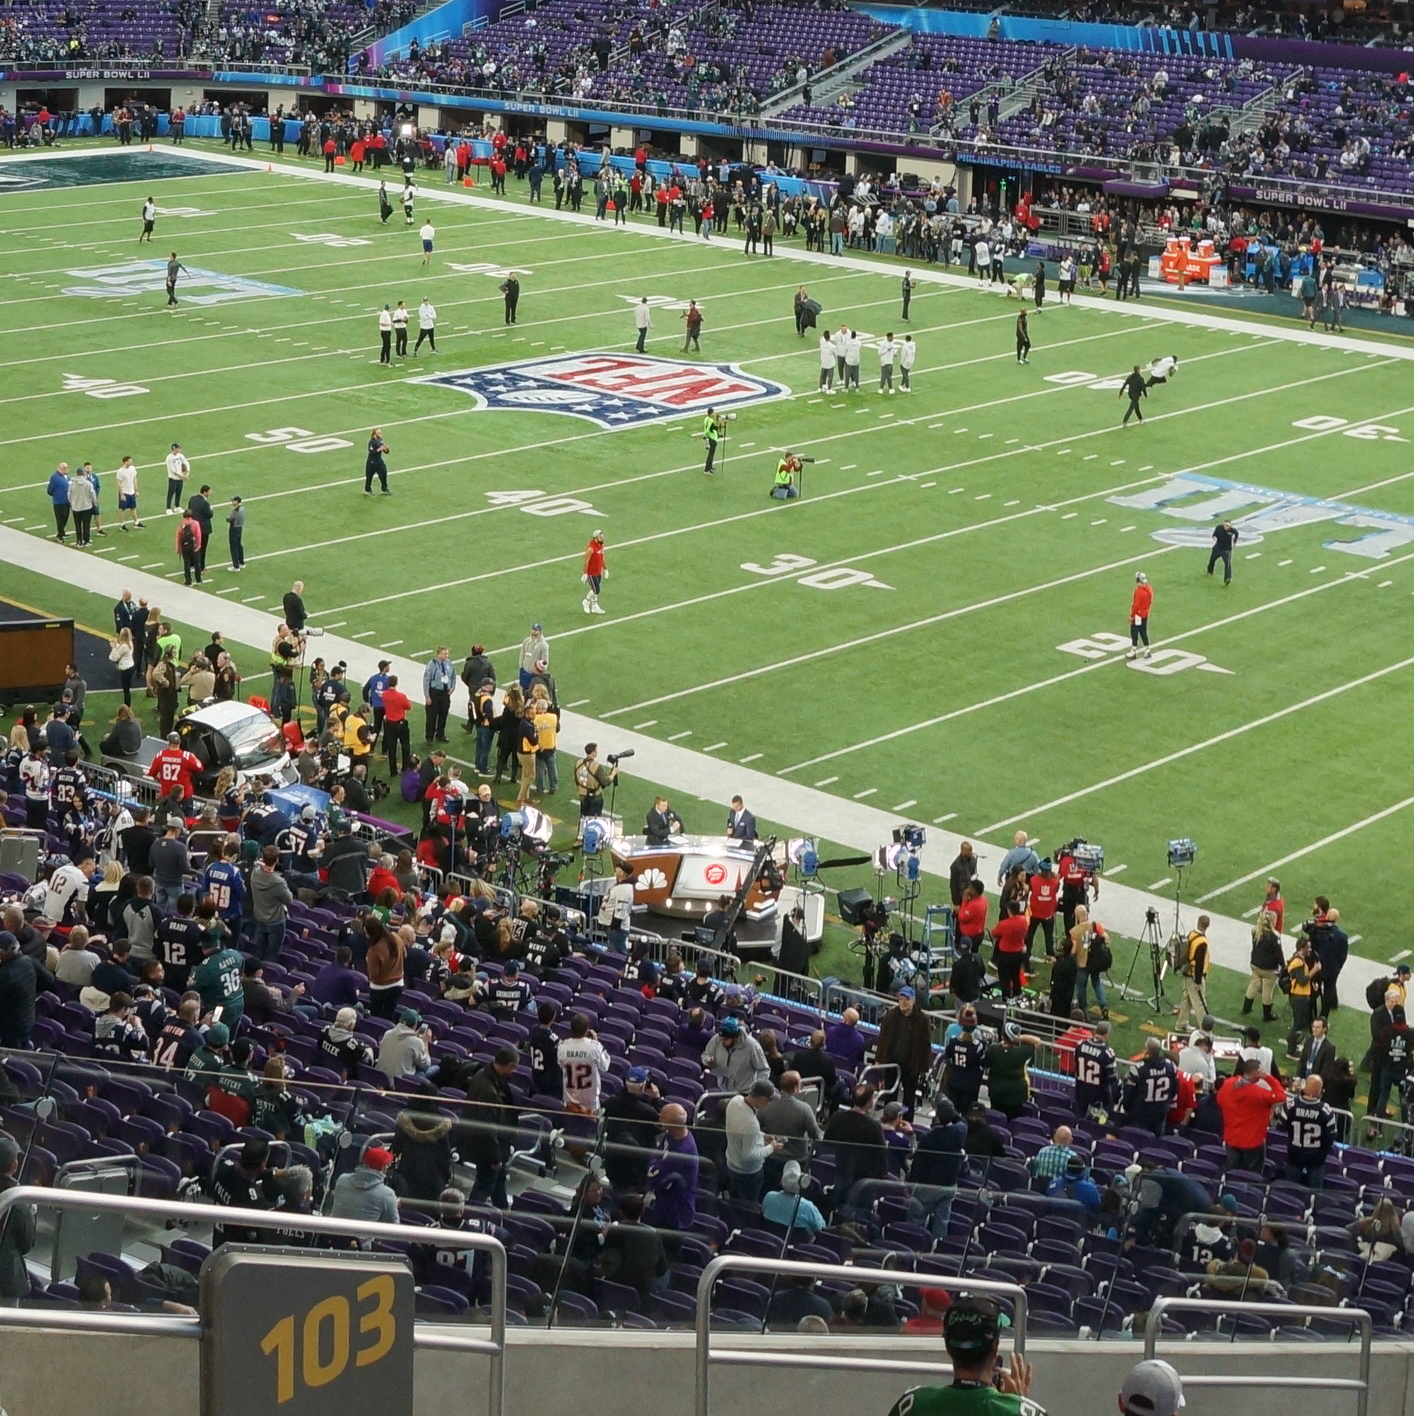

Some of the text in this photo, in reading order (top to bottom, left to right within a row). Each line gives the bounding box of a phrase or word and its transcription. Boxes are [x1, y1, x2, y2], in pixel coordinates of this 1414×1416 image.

[66, 71, 150, 79] SUPER BOWL LII
[504, 103, 579, 117] SUPER BOWL LII
[956, 153, 1062, 174] PHILADELPHIA EAGLES
[1256, 190, 1347, 210] SUPER BOWL LII
[245, 427, 355, 454] 50
[485, 489, 593, 516] 40
[741, 554, 875, 589] 30
[1056, 632, 1209, 676] 20
[162, 764, 182, 782] 87
[57, 785, 75, 802] 83
[50, 874, 68, 893] 12
[209, 883, 231, 909] 59
[163, 941, 186, 965] 12
[528, 941, 548, 953] WENTZ
[220, 968, 240, 997] 36
[153, 1041, 180, 1070] 34
[531, 1046, 545, 1070] 12
[566, 1049, 588, 1059] BRADY
[954, 1053, 967, 1067] 12
[1081, 1044, 1102, 1058] BRADY
[563, 1063, 593, 1090] 12
[1078, 1057, 1100, 1084] 12
[1145, 1077, 1170, 1102] 12
[1295, 1107, 1320, 1120] BRADY
[1291, 1121, 1321, 1148] 12
[1192, 1245, 1213, 1263] 12
[259, 1274, 396, 1403] 103
